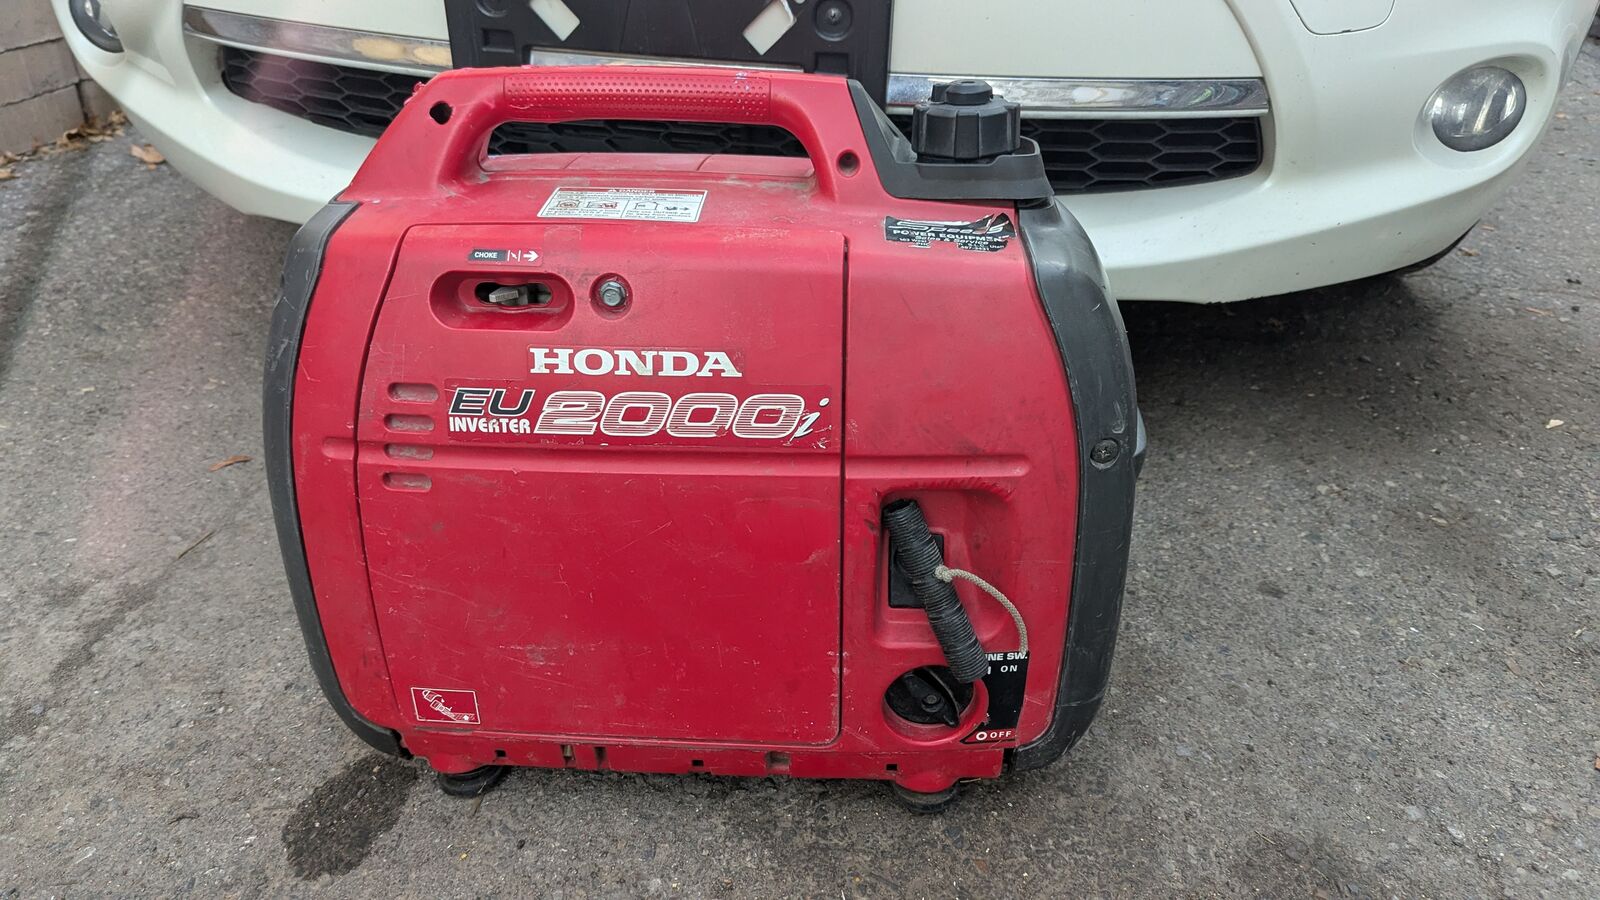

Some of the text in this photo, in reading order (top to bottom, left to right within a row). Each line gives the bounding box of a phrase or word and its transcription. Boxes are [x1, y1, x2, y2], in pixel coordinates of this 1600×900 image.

[474, 251, 498, 259] CHOKE
[529, 347, 743, 378] HONDA
[449, 388, 830, 439] EU 2000i
[449, 418, 531, 434] INVERTER
[1000, 664, 1018, 673] ON
[990, 730, 1012, 739] OFF
